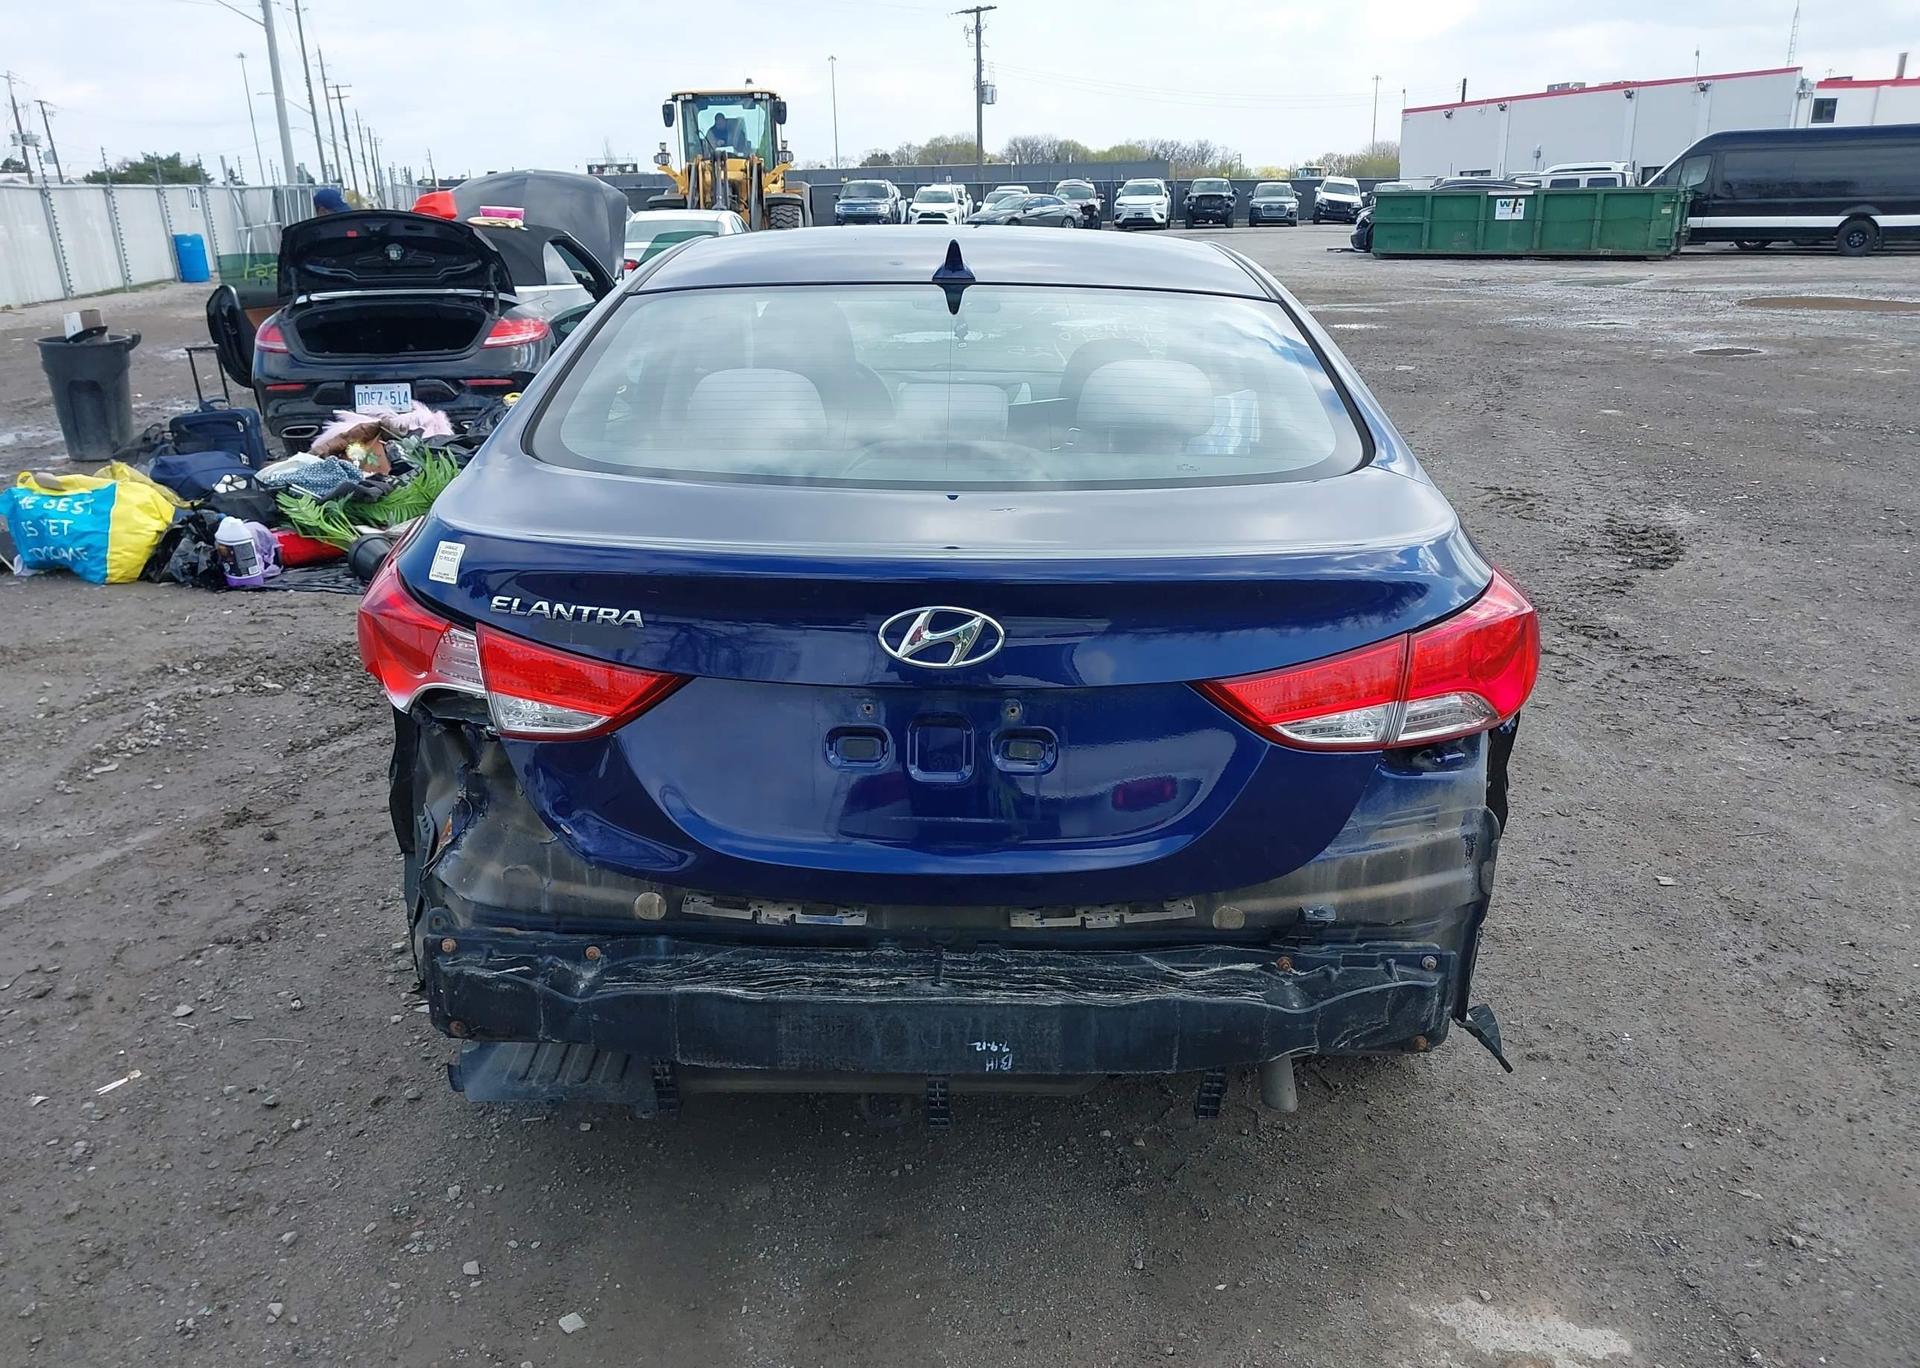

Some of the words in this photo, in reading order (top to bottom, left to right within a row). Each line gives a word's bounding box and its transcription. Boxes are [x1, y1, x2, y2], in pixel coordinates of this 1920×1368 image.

[390, 390, 409, 405] 514
[21, 520, 39, 537] IS
[490, 595, 644, 628] ELANTRA
